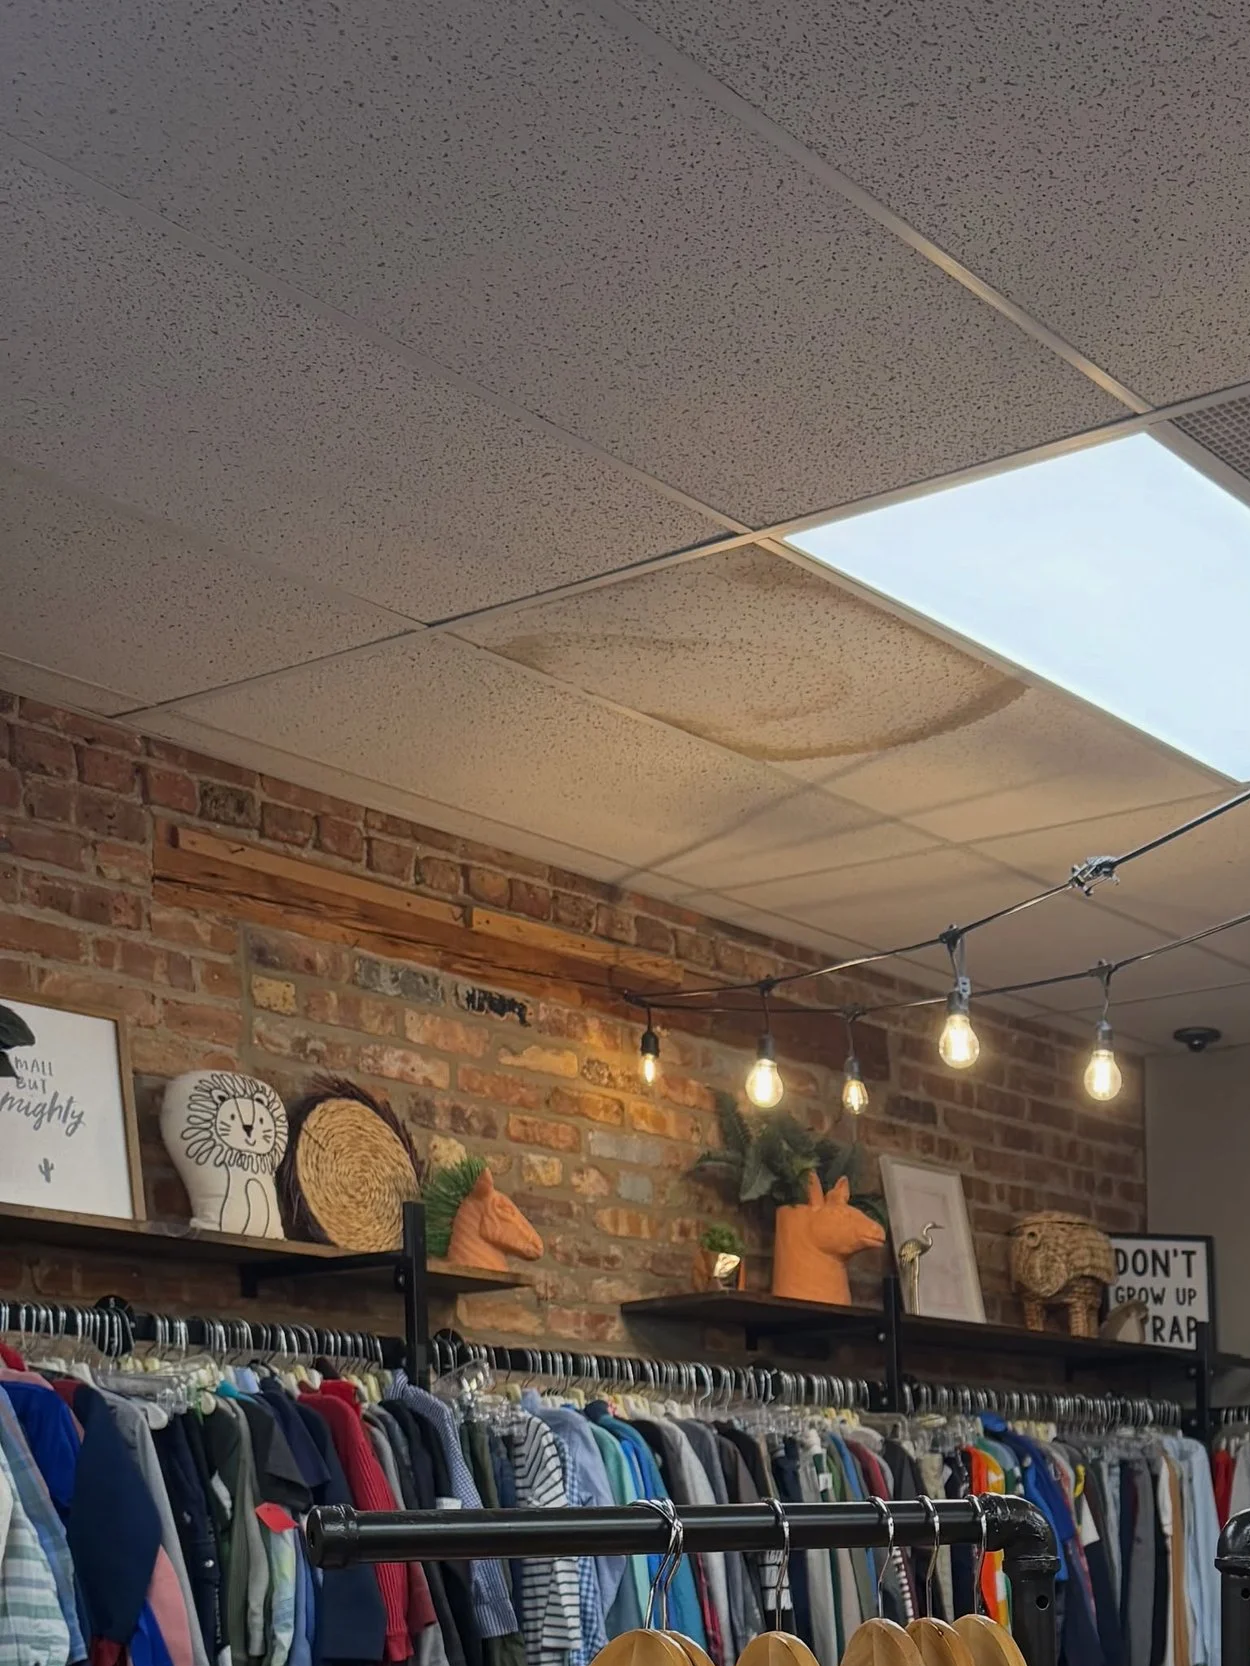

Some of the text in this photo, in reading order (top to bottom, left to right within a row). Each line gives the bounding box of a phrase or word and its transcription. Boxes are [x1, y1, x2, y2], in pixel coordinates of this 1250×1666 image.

[14, 1056, 53, 1077] MALL
[16, 1076, 47, 1094] BUT
[0, 1091, 87, 1137] mighty
[1114, 1248, 1197, 1278] DON'T
[1115, 1286, 1197, 1306] GROW UP
[1148, 1315, 1198, 1343] RAP
